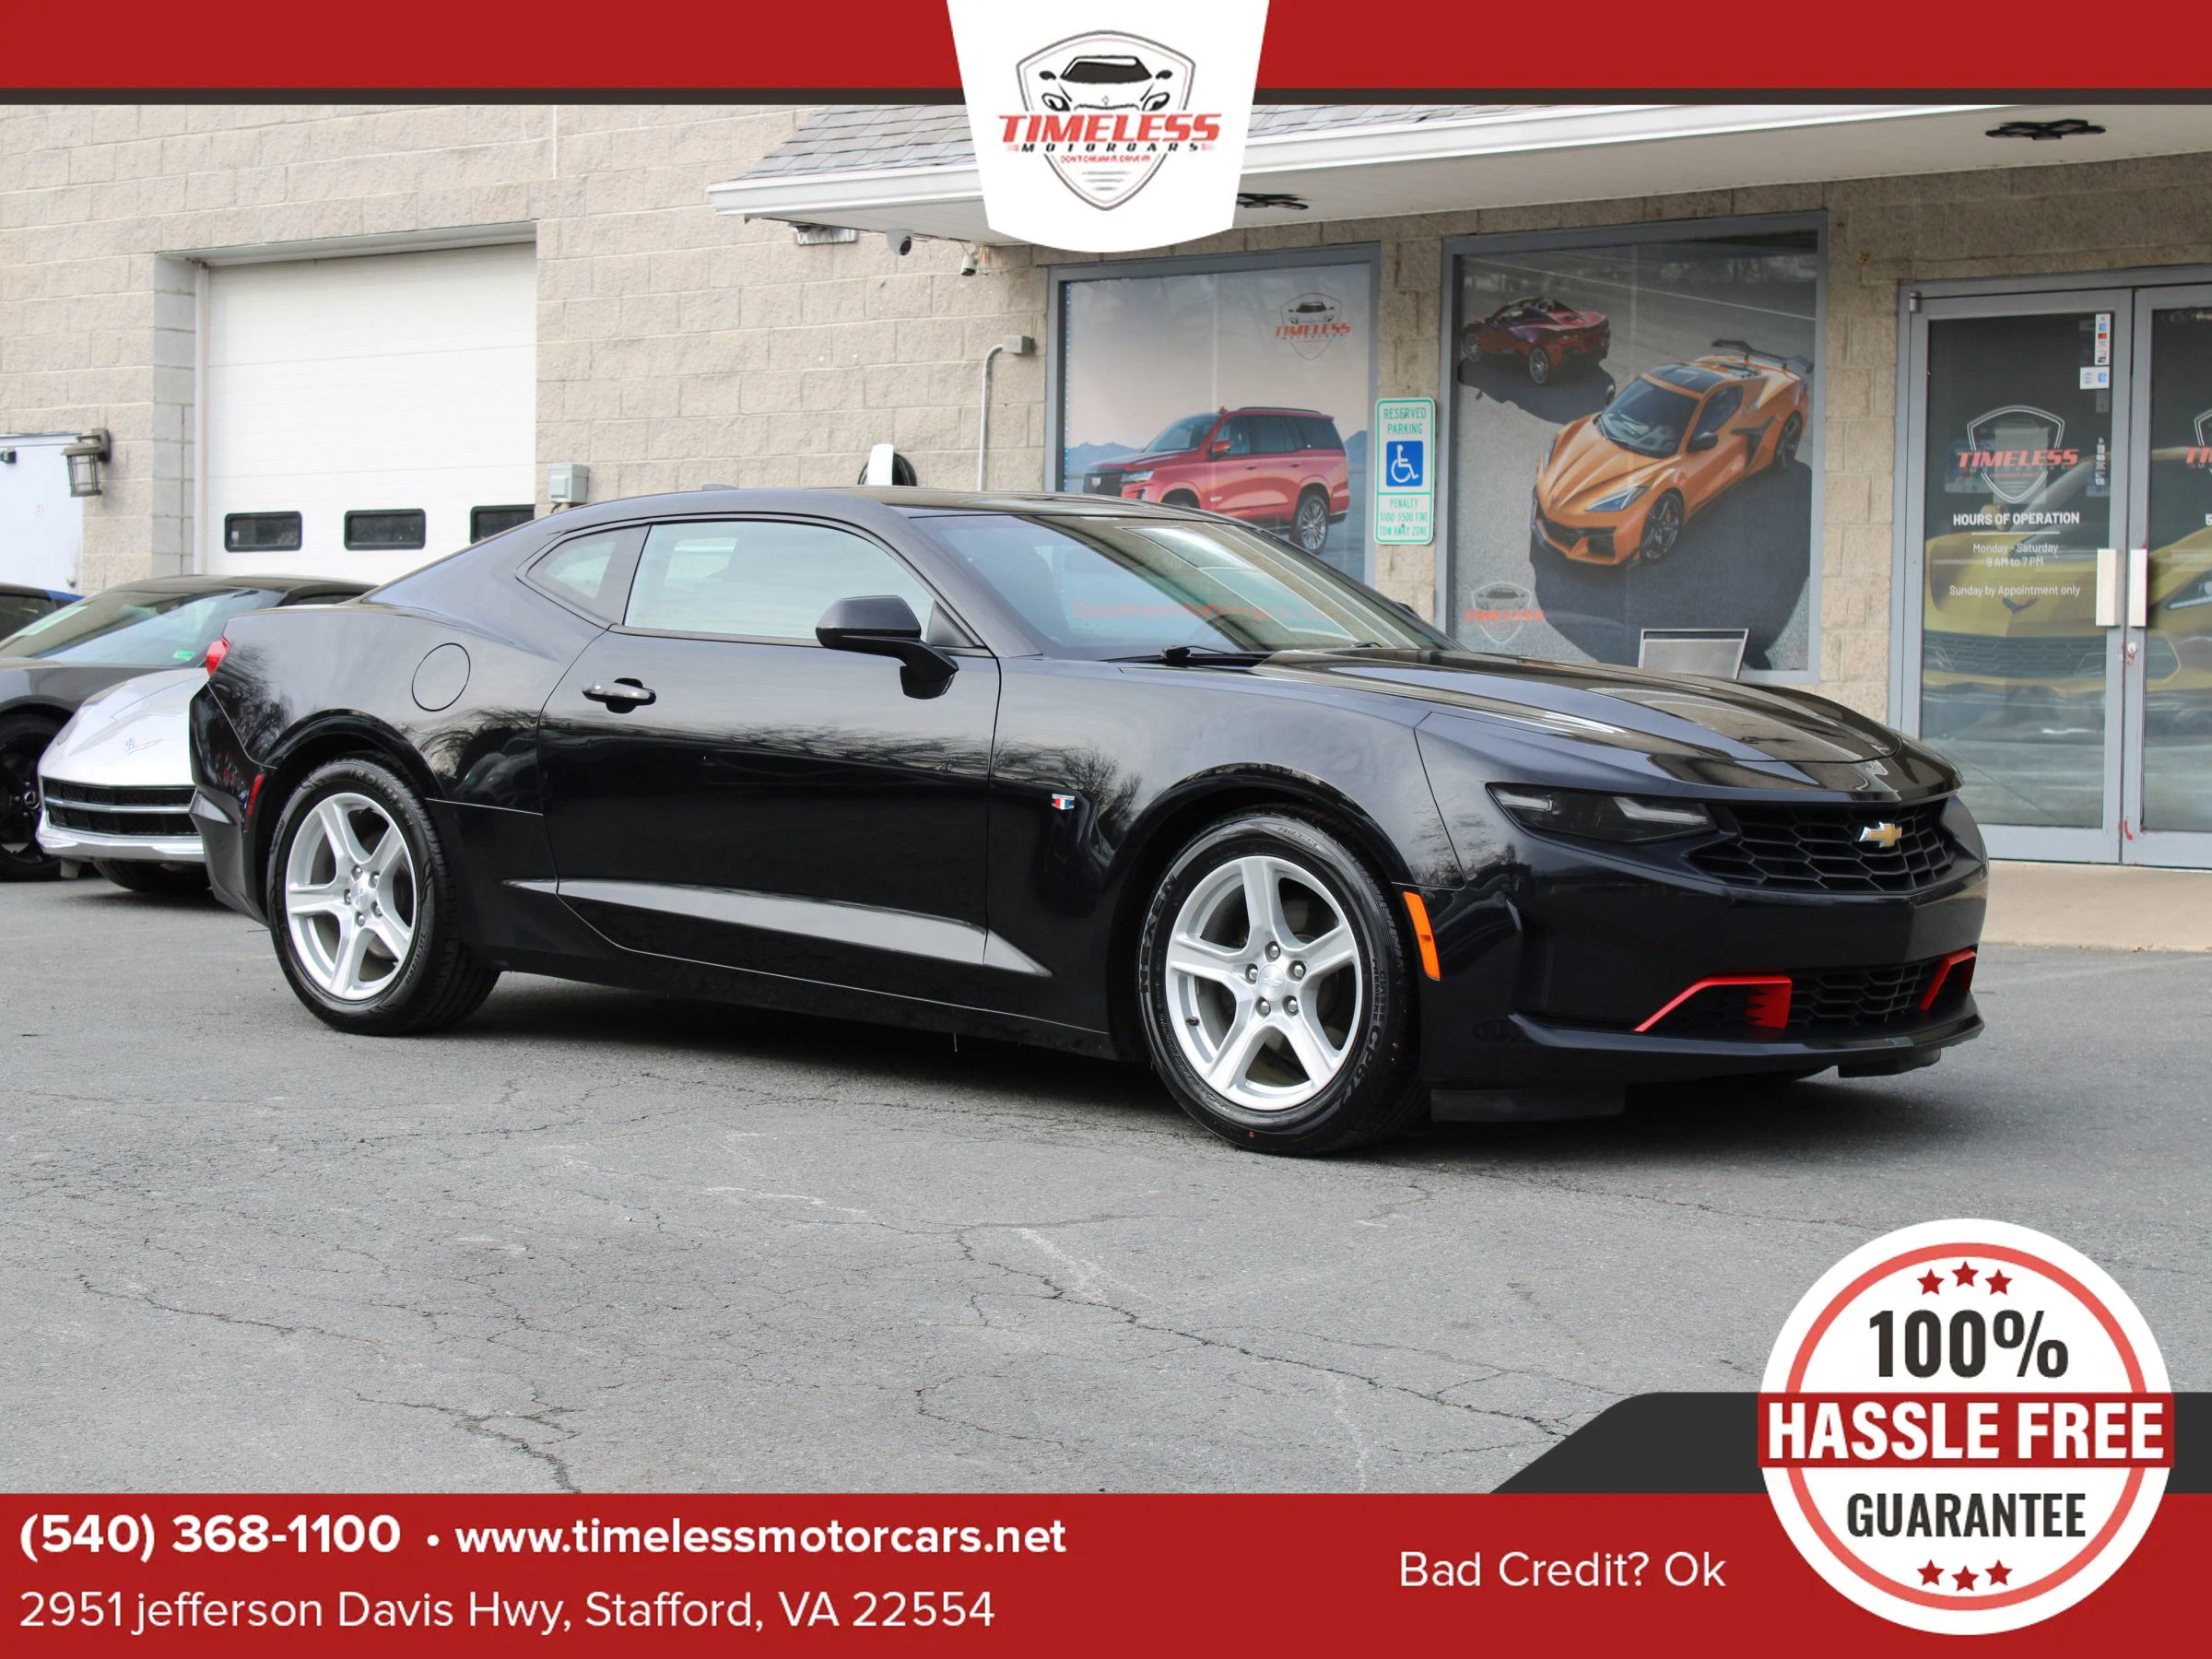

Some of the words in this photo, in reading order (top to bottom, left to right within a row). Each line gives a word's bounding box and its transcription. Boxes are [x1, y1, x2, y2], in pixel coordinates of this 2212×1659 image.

[1383, 407, 1427, 419] RESERVED
[1387, 423, 1423, 435] PARKING
[1958, 449, 2080, 468] TIMELESS
[1389, 499, 1418, 509] PENALTY
[1953, 513, 1993, 526] HOURS
[1994, 512, 2010, 525] OF
[2012, 512, 2080, 525] OPERATION
[1972, 543, 2008, 555] Monday
[2015, 542, 2059, 555] Saturday
[1994, 558, 2008, 568] AM
[2010, 558, 2020, 568] to
[2021, 557, 2029, 567] 7
[2030, 557, 2043, 567] PM
[1949, 585, 1983, 598] Sunday
[1984, 585, 1995, 597] by
[1997, 585, 2059, 597] Appointment
[2060, 585, 2081, 597] only
[1139, 873, 1178, 993] NEXEN
